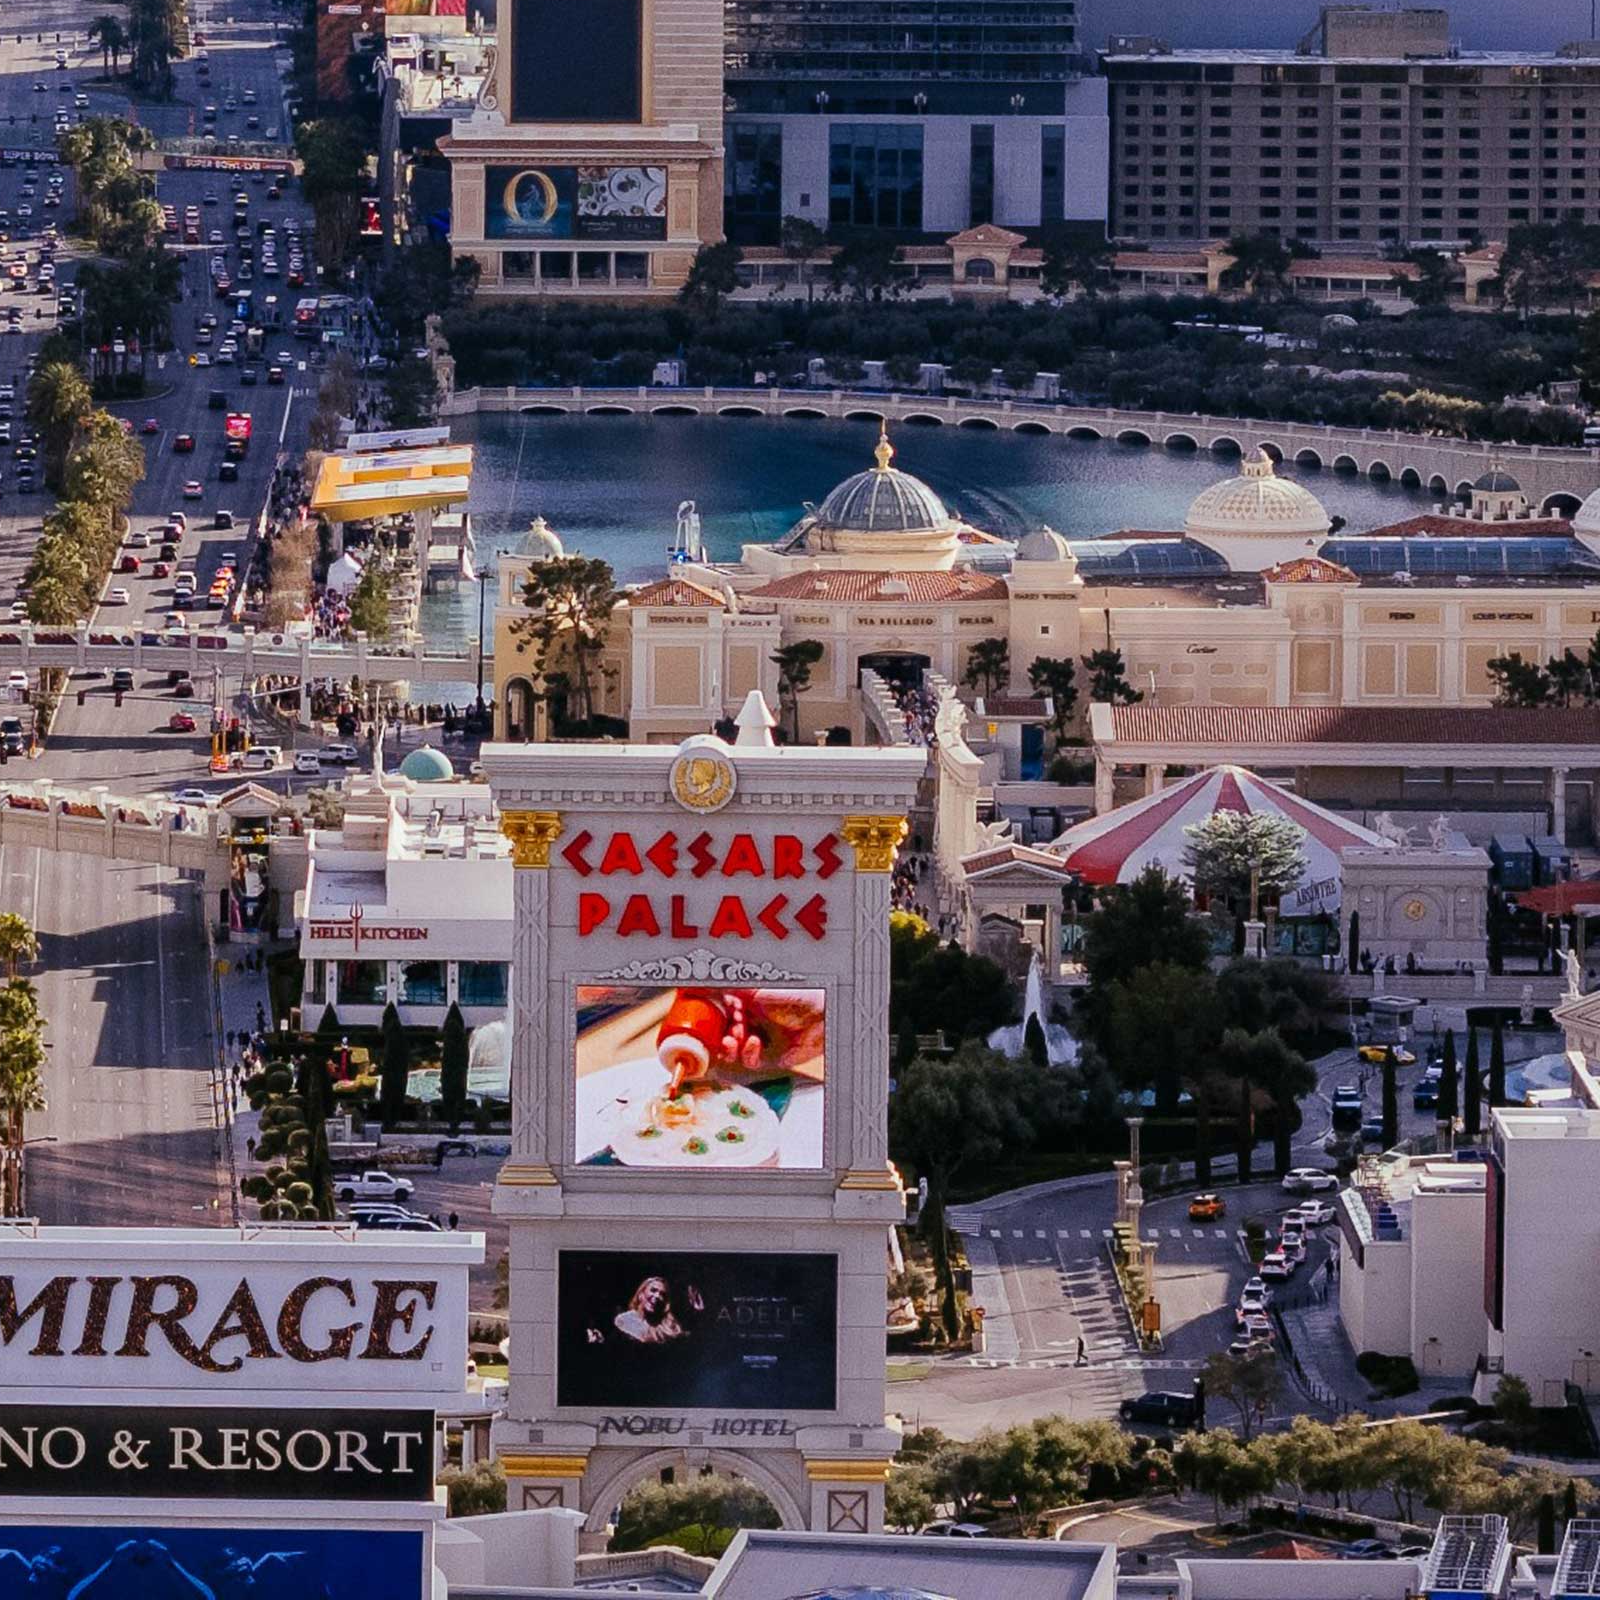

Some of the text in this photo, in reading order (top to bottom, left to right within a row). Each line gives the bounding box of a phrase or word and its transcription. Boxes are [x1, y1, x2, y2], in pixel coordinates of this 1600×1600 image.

[857, 617, 934, 626] VIA BELLAGIO
[560, 829, 844, 880] CAESARS
[360, 926, 429, 940] KITCHEN
[578, 891, 829, 941] PALACE
[600, 1415, 796, 1437] NOBU HOTEL
[108, 1428, 151, 1470] &
[169, 1426, 423, 1475] RESORT
